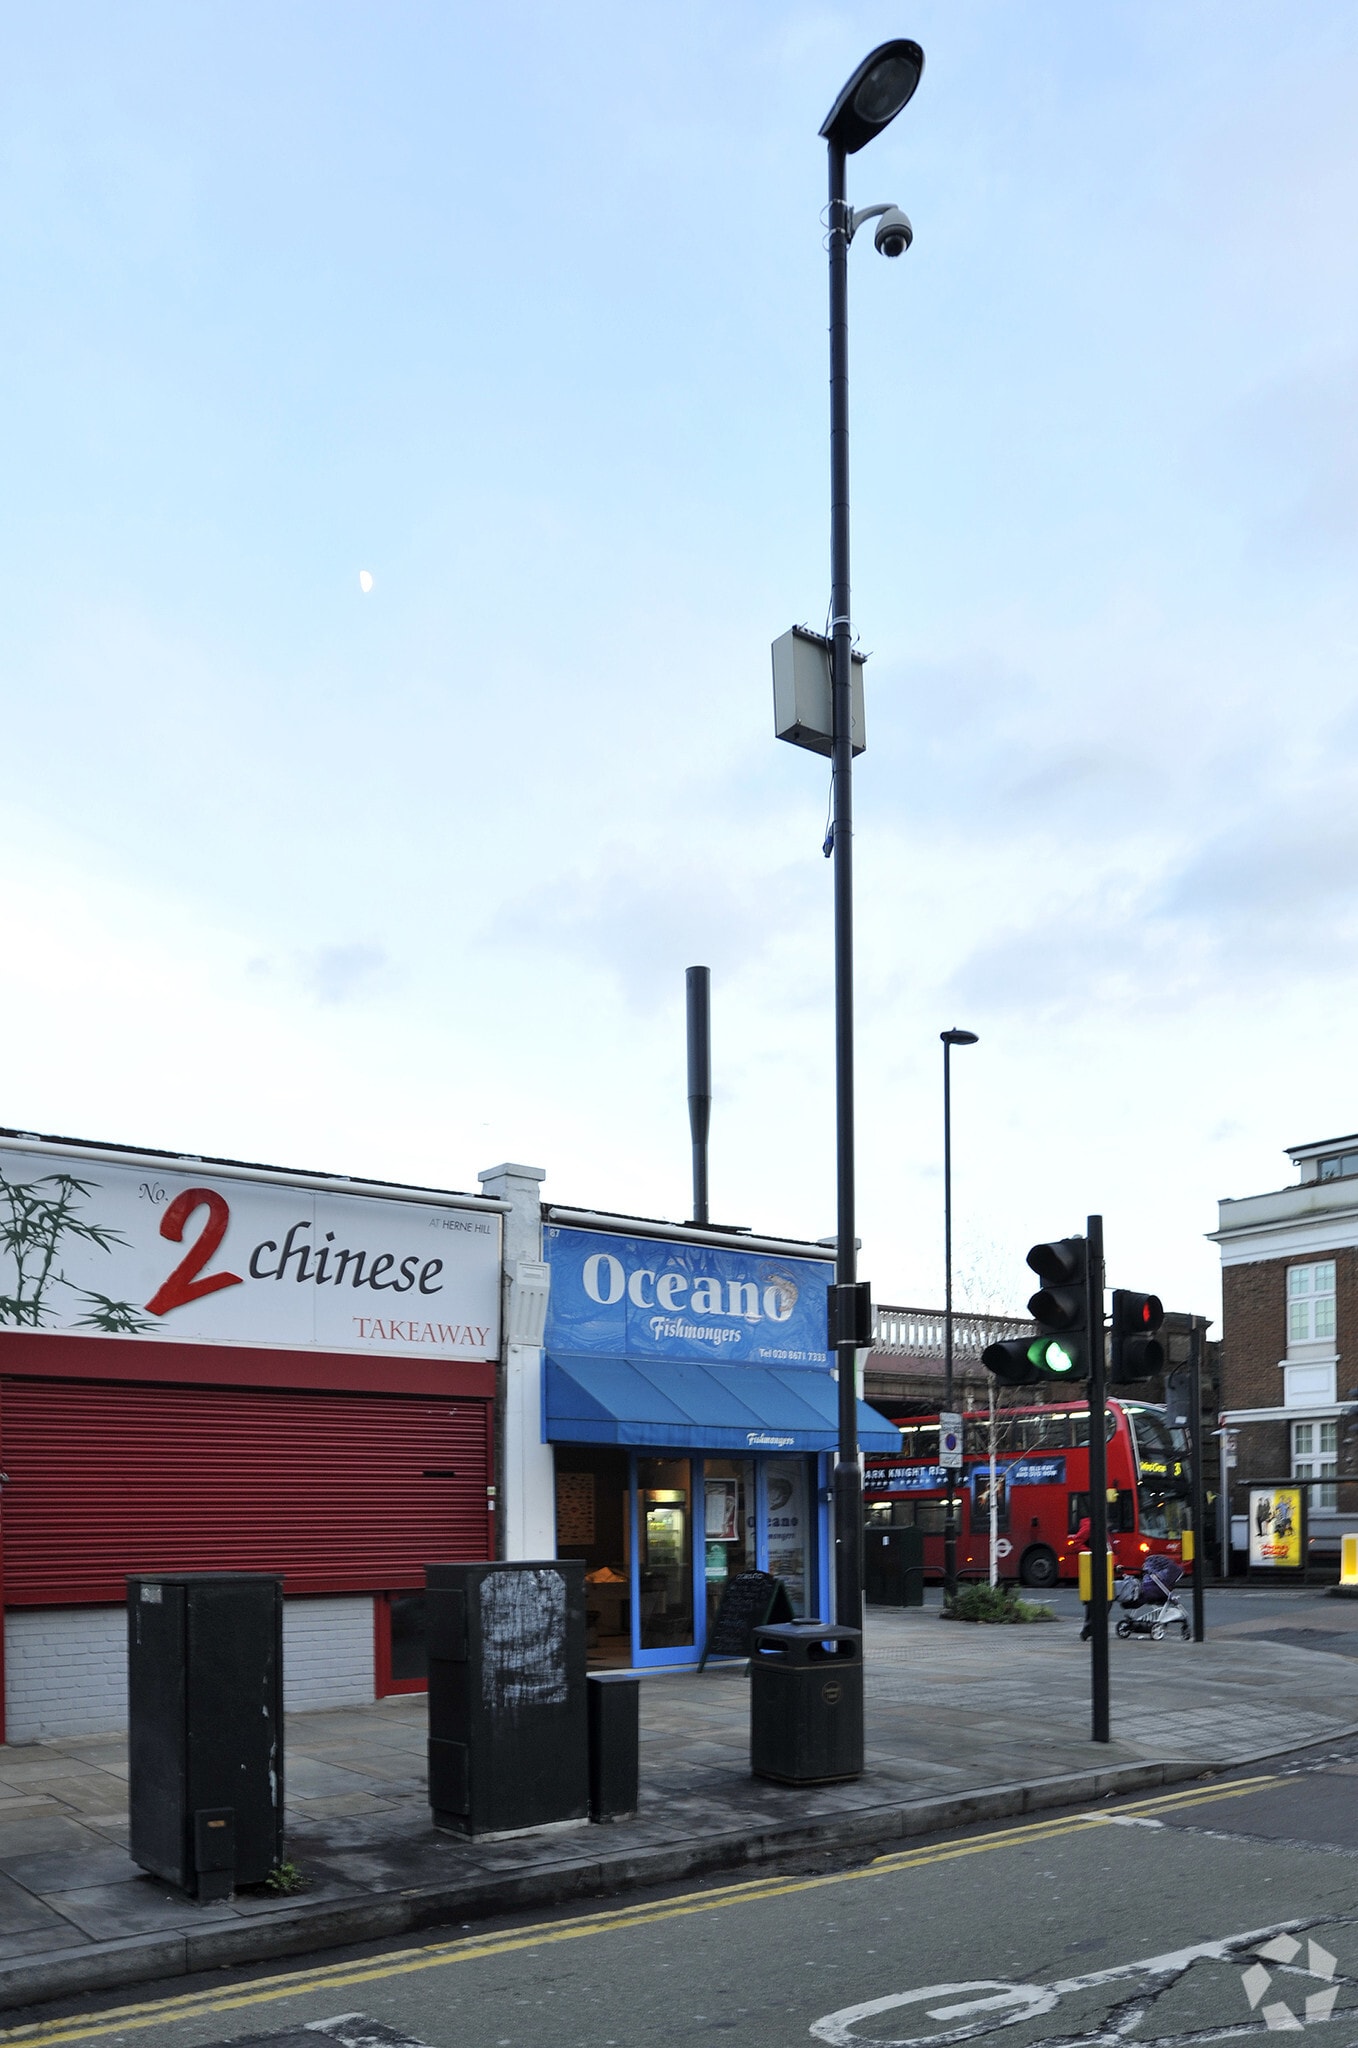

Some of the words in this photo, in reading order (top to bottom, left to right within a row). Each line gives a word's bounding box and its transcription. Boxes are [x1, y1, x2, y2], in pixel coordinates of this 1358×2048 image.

[139, 1182, 169, 1204] No.
[442, 1219, 473, 1233] HERNE
[474, 1223, 492, 1235] HILL
[549, 1228, 561, 1239] 87
[144, 1187, 244, 1317] 2
[248, 1220, 444, 1295] chinese
[582, 1253, 795, 1322] Oceano
[352, 1316, 491, 1347] TAKEAWAY
[649, 1316, 742, 1346] Fishmongers
[759, 1348, 772, 1358] Tel
[772, 1349, 787, 1360] 020
[746, 1432, 795, 1447] Fishmongers
[888, 1466, 927, 1478] KNIGHT
